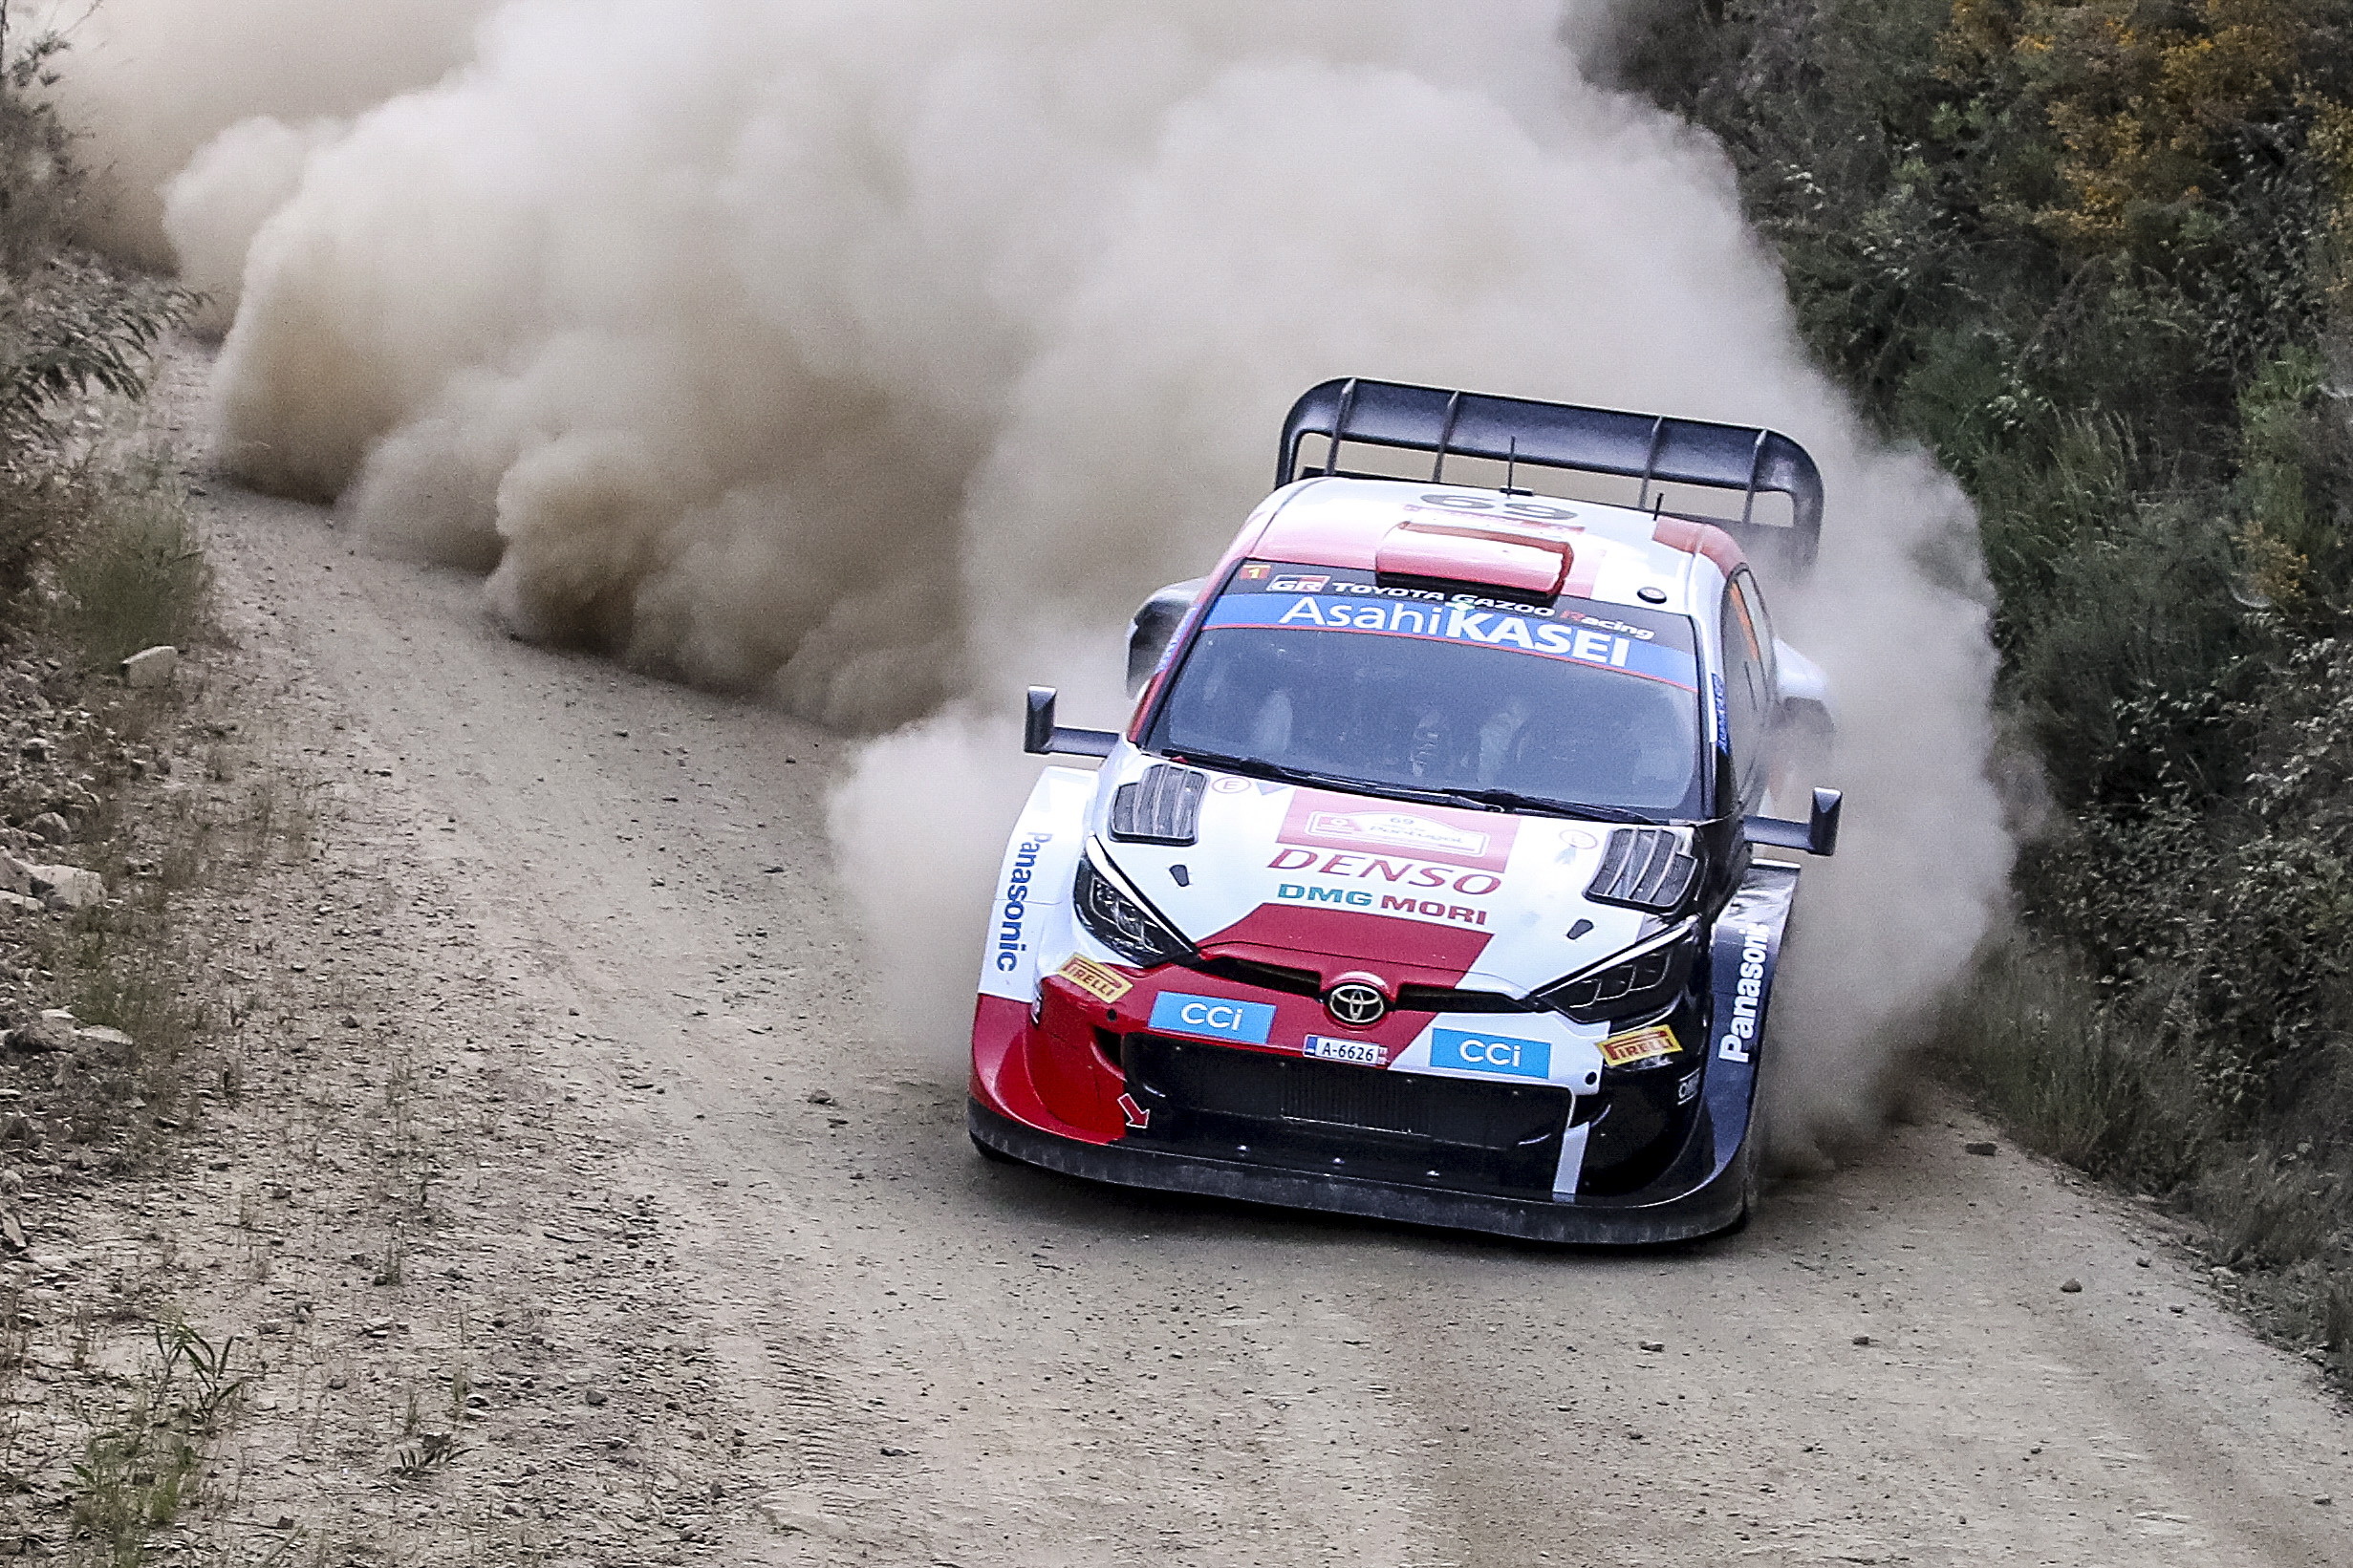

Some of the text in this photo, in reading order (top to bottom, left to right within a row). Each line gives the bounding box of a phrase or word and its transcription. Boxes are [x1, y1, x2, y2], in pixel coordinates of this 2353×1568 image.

[1420, 494, 1579, 520] 69
[1270, 578, 1656, 640] GR TOYOTA GAZOO Racing
[1266, 848, 1502, 895] DENSO
[997, 831, 1053, 973] Panasonic
[1277, 883, 1487, 925] DMG MORI
[1062, 959, 1123, 997] PIRELLI
[1322, 1042, 1374, 1062] A-6626
[1604, 1030, 1674, 1061] PIRELLI
